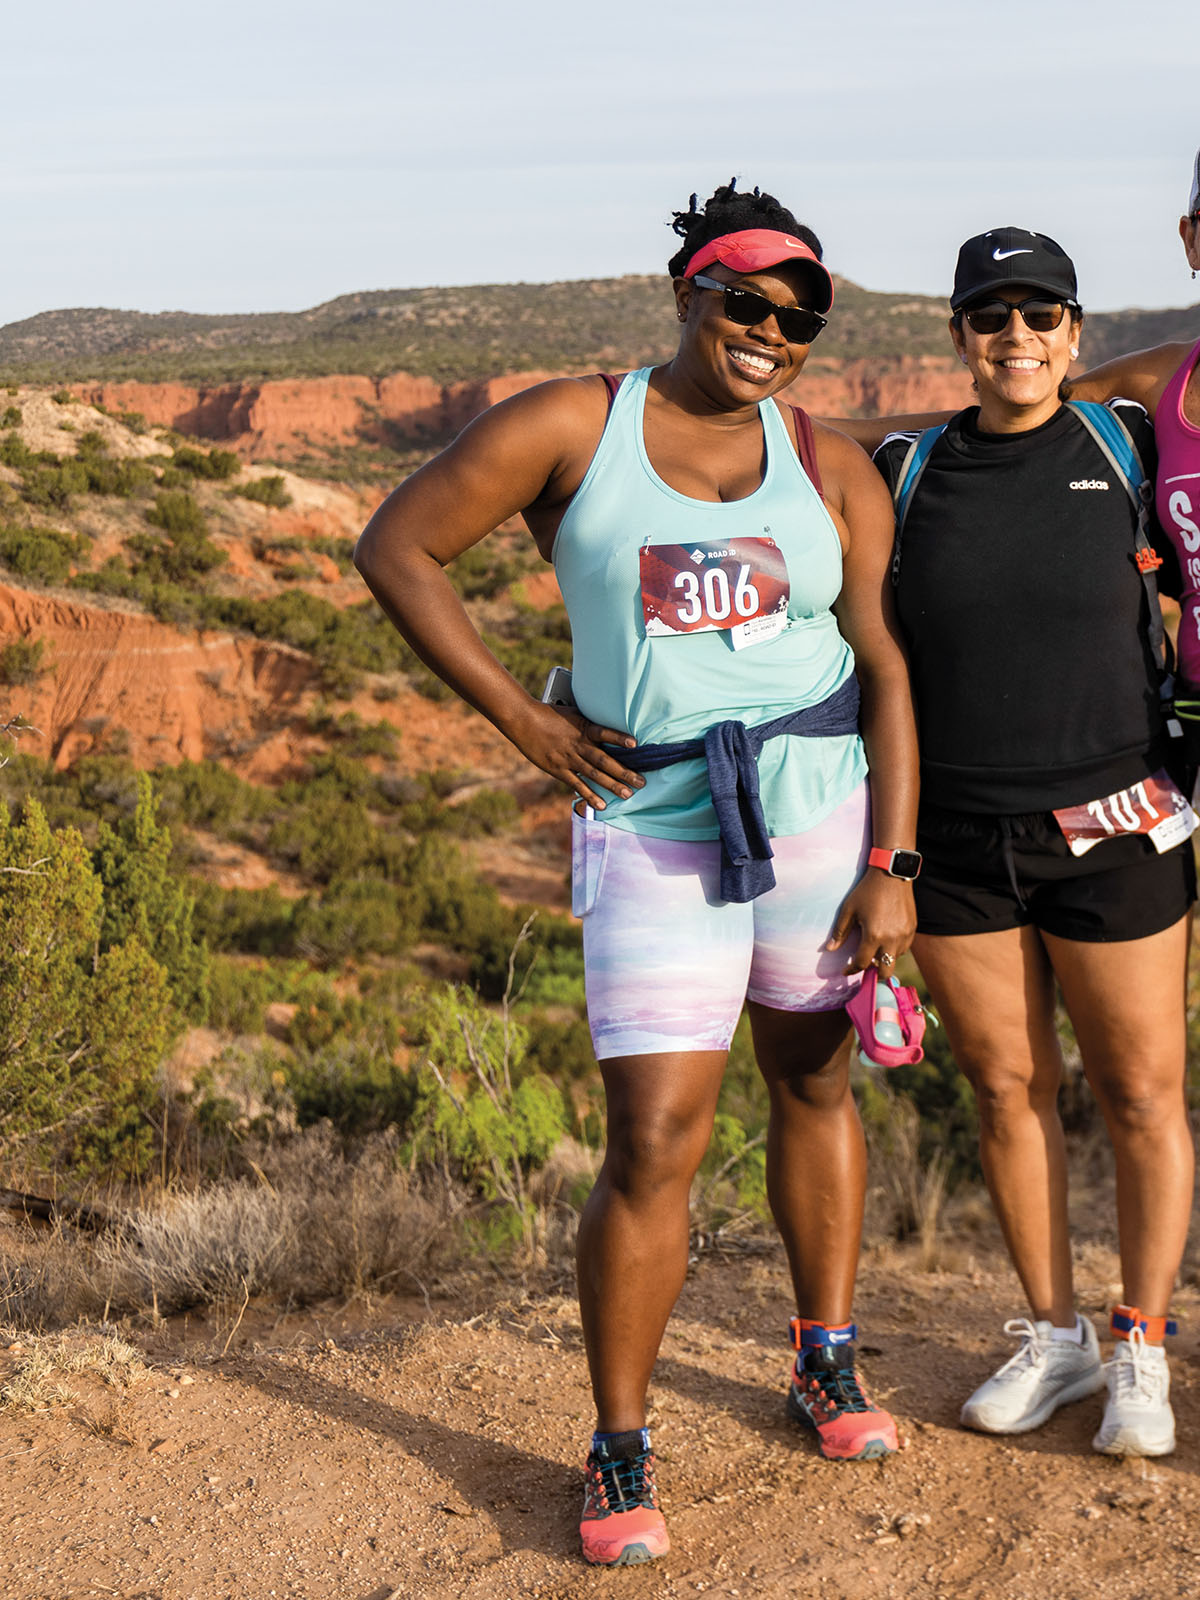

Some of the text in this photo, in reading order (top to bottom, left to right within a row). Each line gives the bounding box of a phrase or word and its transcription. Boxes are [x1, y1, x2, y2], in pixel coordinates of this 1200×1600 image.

[1069, 479, 1109, 490] adidas
[707, 551, 728, 559] ROAD
[674, 565, 760, 624] 306
[1087, 781, 1159, 835] 101
